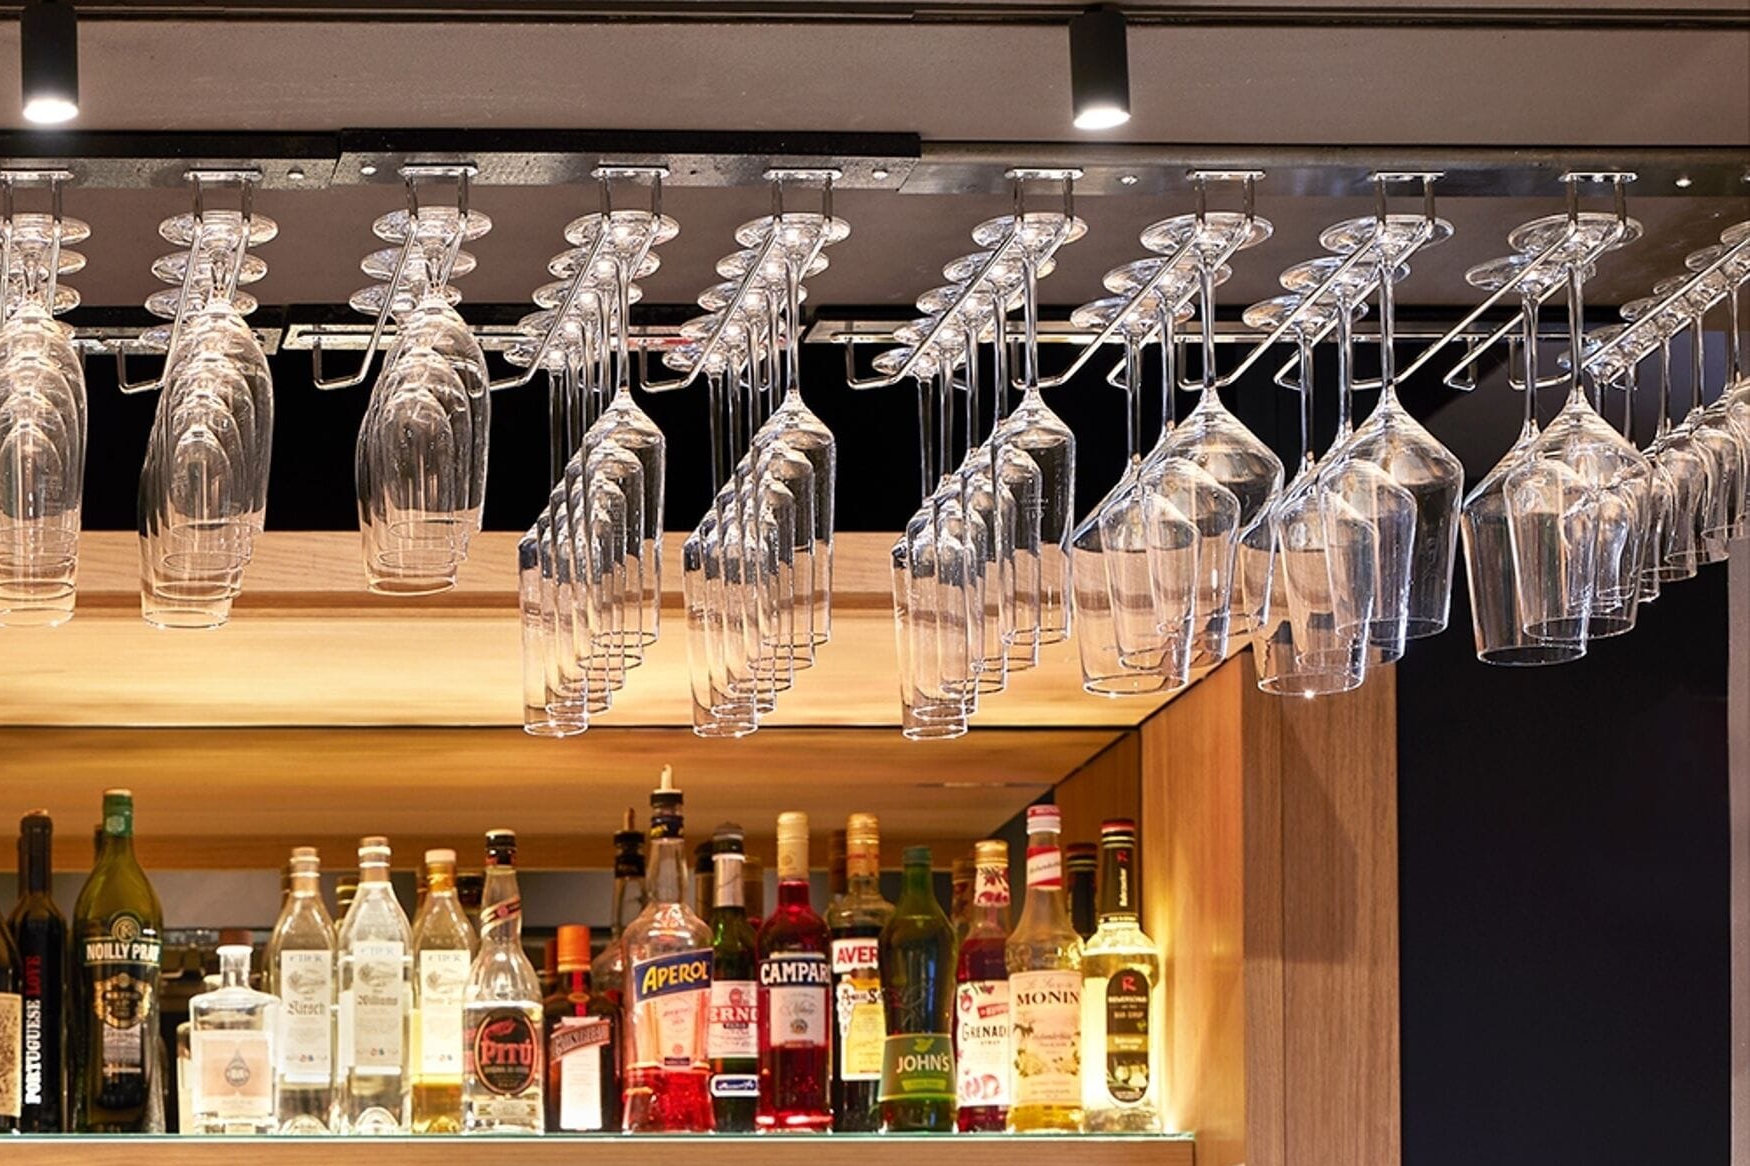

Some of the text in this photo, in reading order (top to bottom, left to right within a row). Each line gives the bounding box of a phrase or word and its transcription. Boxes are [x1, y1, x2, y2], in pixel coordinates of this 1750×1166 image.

[86, 944, 129, 961] NOILLY
[835, 946, 879, 964] AVER
[641, 960, 708, 995] APEROL
[1016, 991, 1081, 1006] MONIN
[25, 955, 42, 1106] PORTUGUESE LOVE
[896, 1053, 950, 1074] JOHN'S
